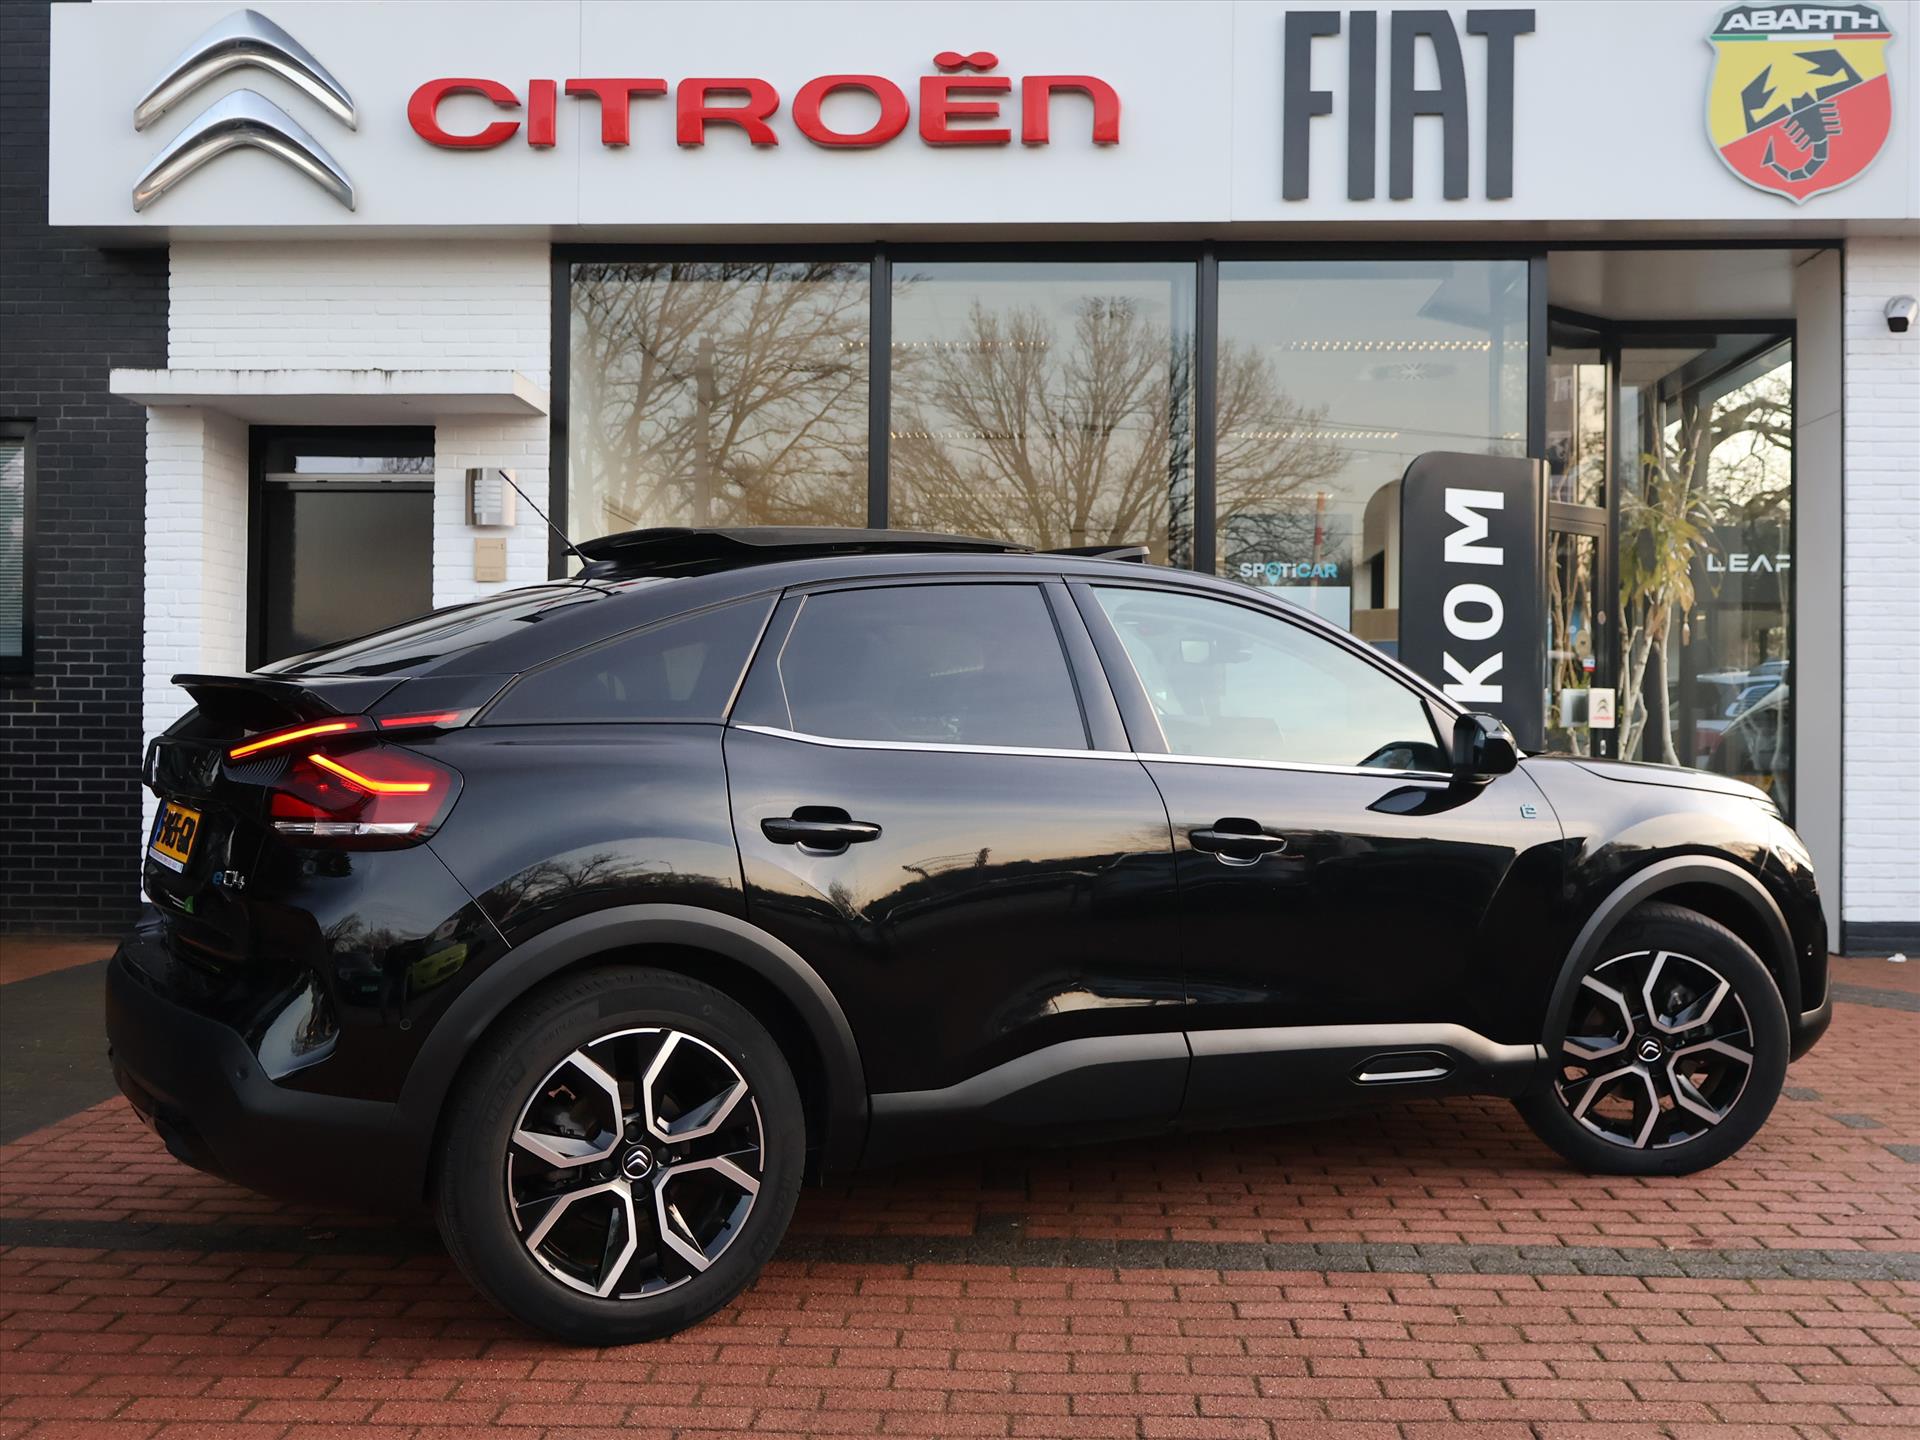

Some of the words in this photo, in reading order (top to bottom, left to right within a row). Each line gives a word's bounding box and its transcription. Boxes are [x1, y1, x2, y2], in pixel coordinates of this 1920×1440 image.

[1282, 9, 1536, 201] FIAT
[1722, 8, 1879, 31] ABARTH
[1443, 487, 1505, 703] KOM
